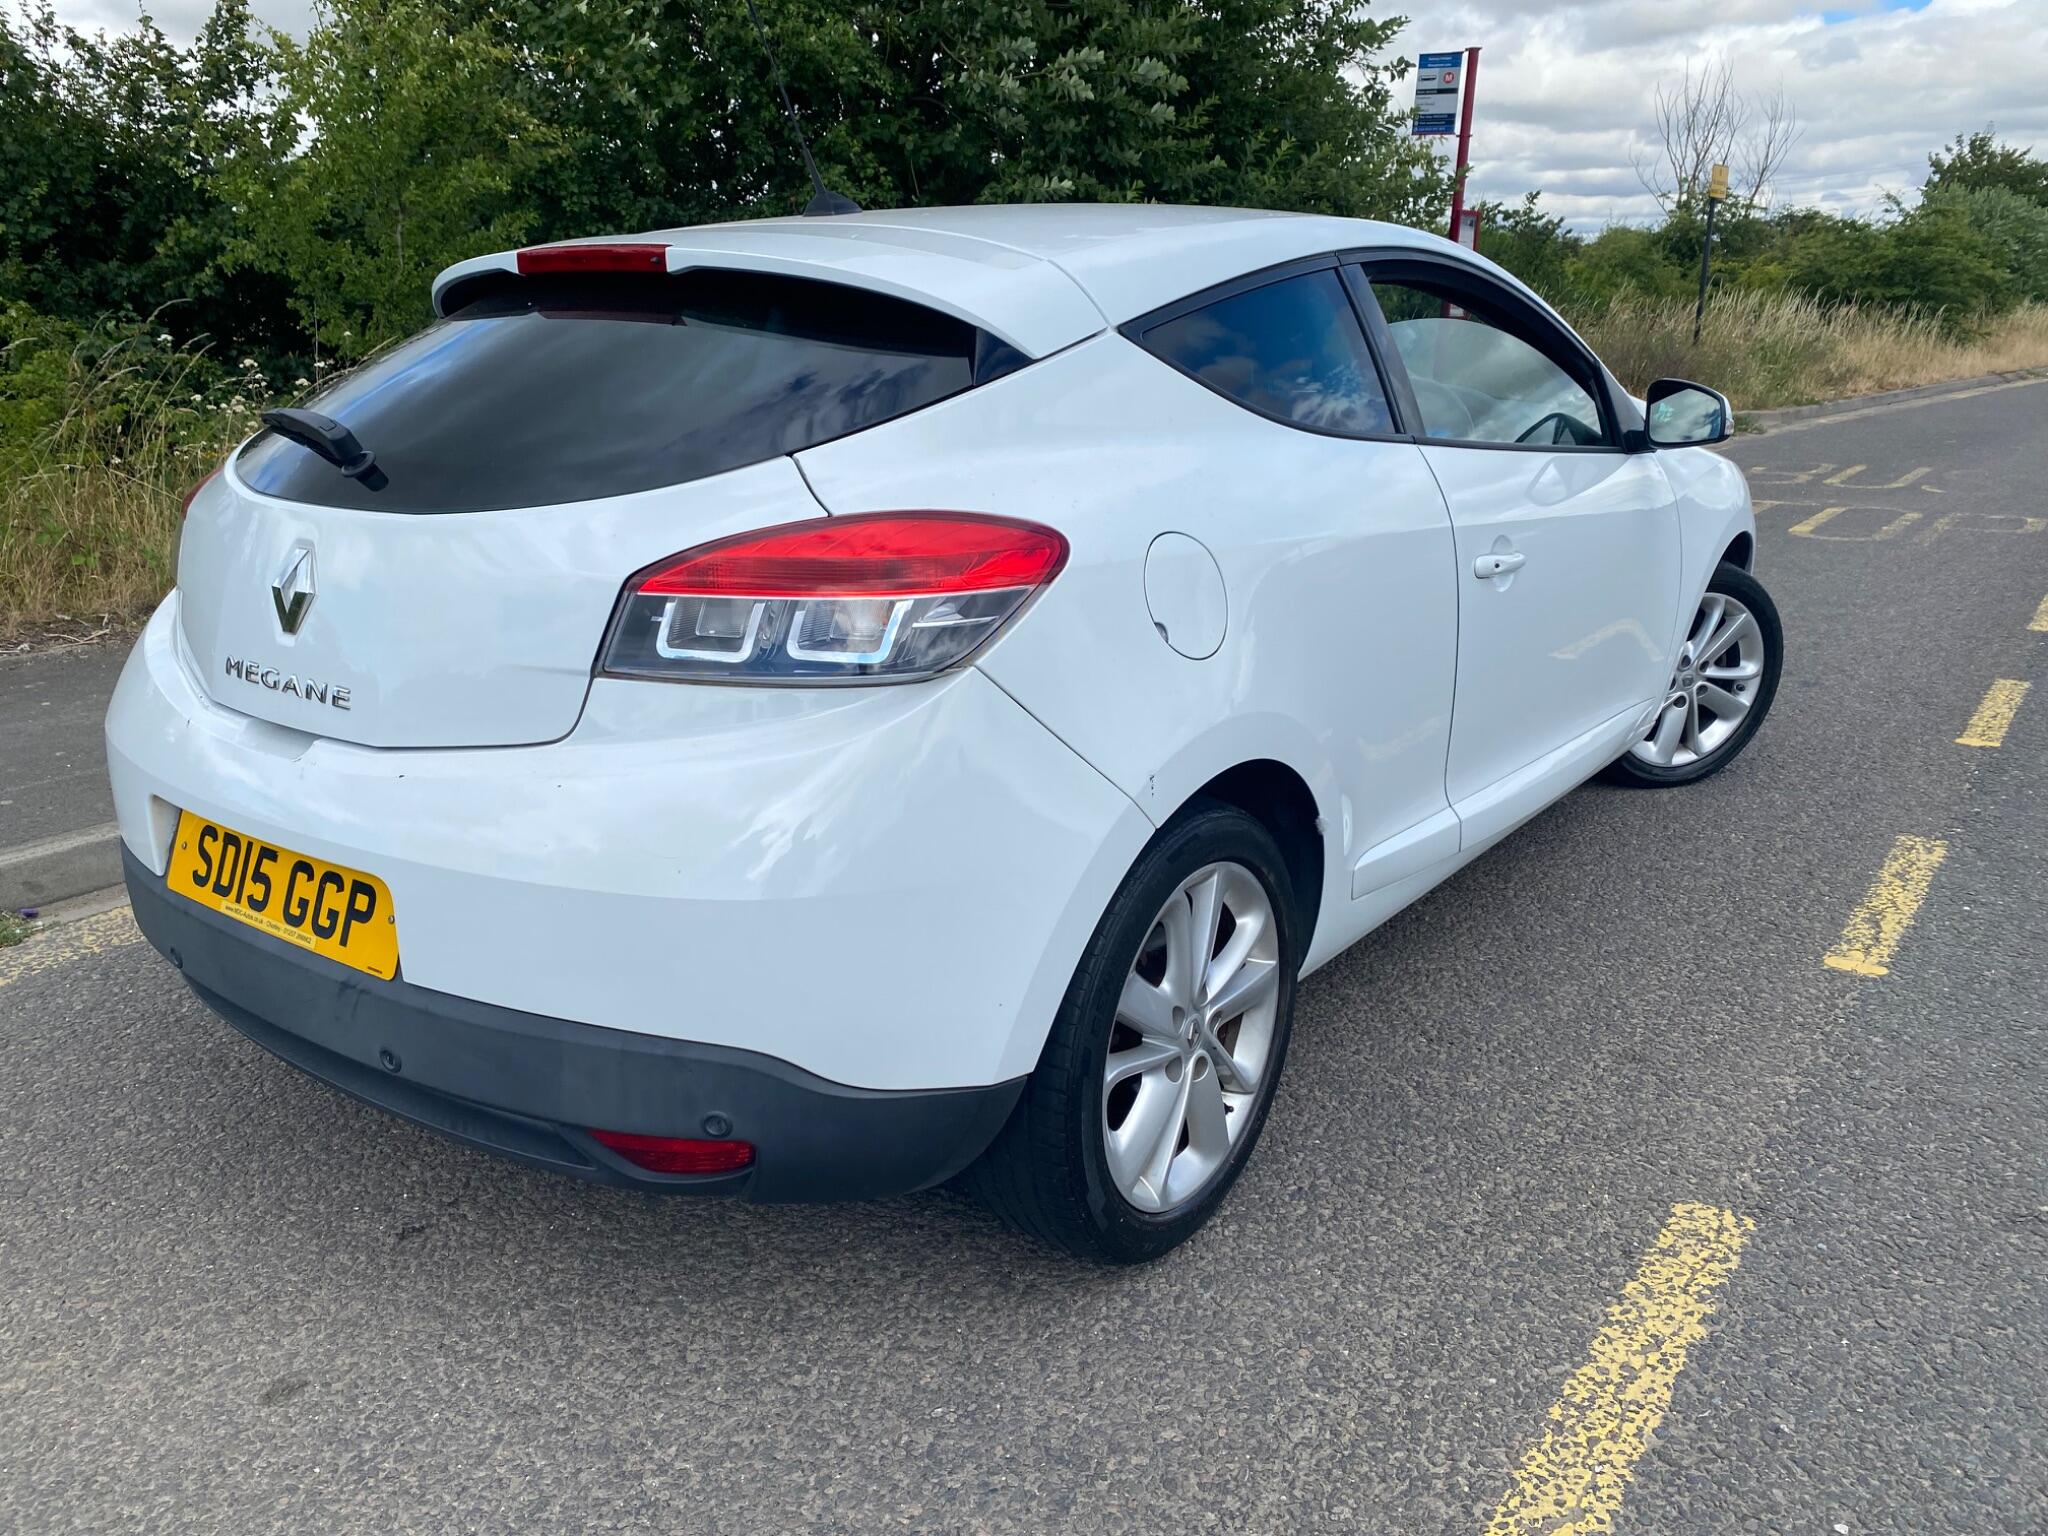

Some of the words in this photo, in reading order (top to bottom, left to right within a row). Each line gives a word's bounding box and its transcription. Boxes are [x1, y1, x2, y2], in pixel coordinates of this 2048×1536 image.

[1752, 500, 2048, 546] OP
[225, 655, 352, 711] MEGANE
[192, 824, 279, 913] SD15
[282, 859, 377, 948] GGP
